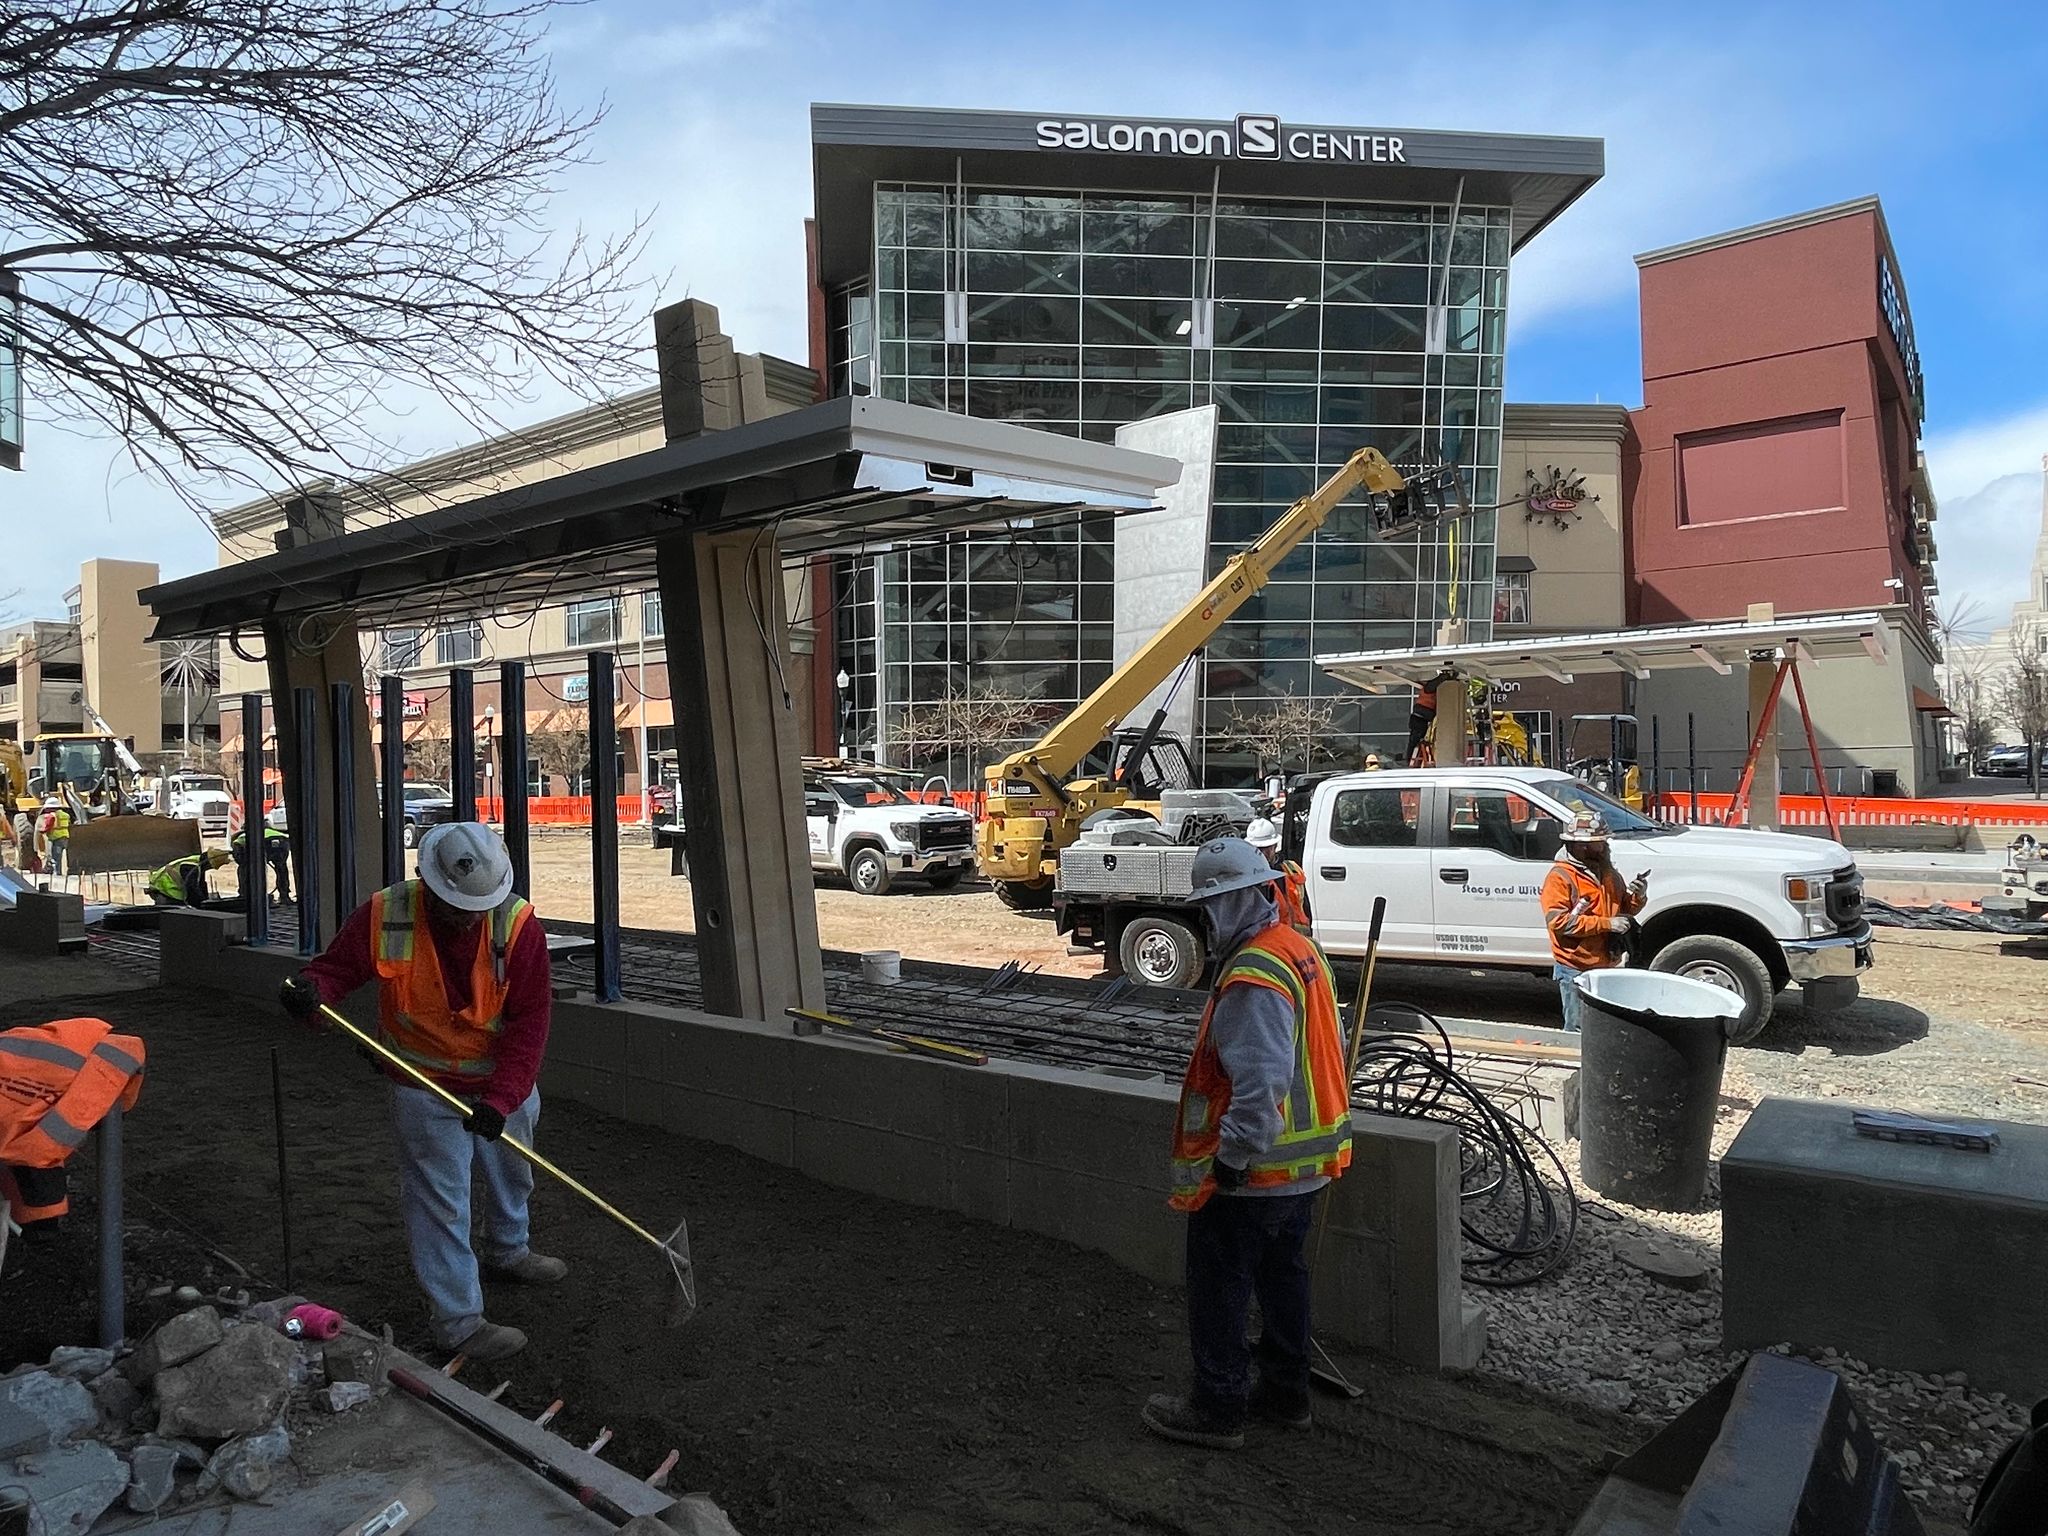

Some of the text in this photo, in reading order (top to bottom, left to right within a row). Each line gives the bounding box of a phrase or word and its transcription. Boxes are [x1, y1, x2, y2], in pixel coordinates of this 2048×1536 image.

[1288, 132, 1406, 163] CENTER
[1230, 576, 1245, 593] CAT
[1462, 885, 1491, 896] Stacy
[1494, 886, 1515, 894] and
